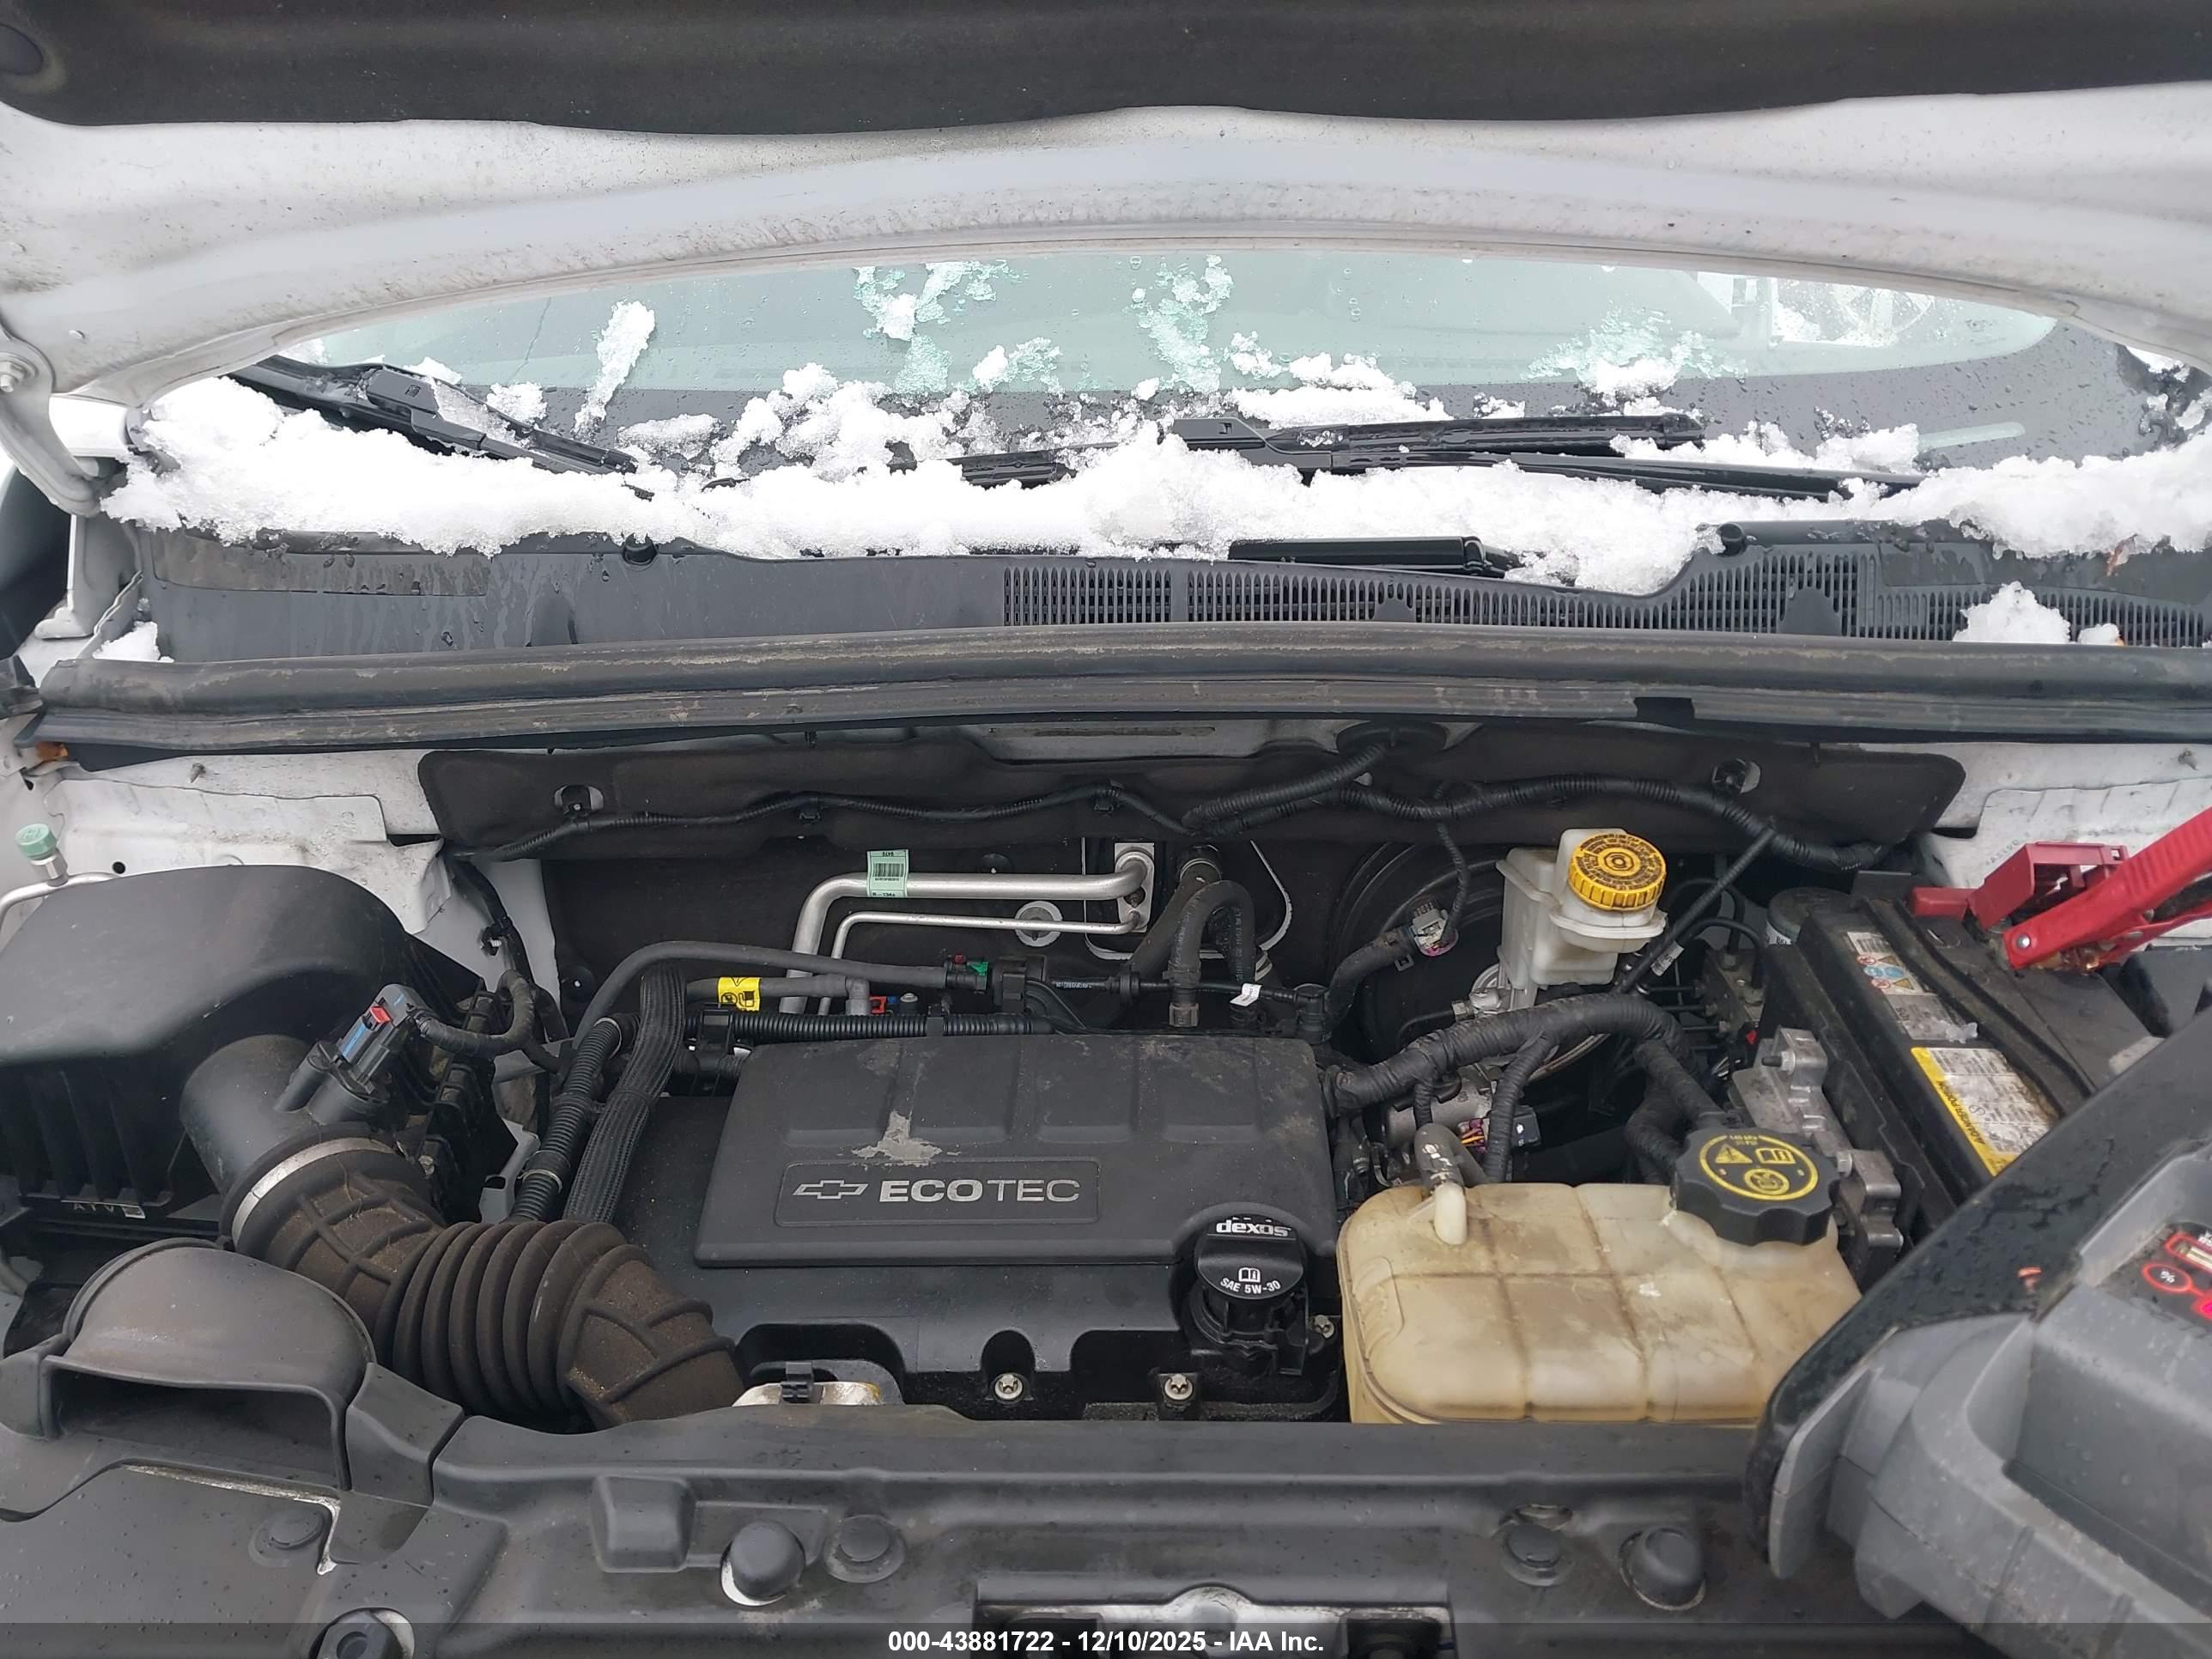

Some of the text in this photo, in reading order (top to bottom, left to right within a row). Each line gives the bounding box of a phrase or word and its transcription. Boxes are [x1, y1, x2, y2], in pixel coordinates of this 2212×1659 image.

[879, 1179, 1080, 1202] ECOTEC
[1216, 1219, 1291, 1237] dexos
[1220, 1278, 1281, 1294] SAE 5W-30
